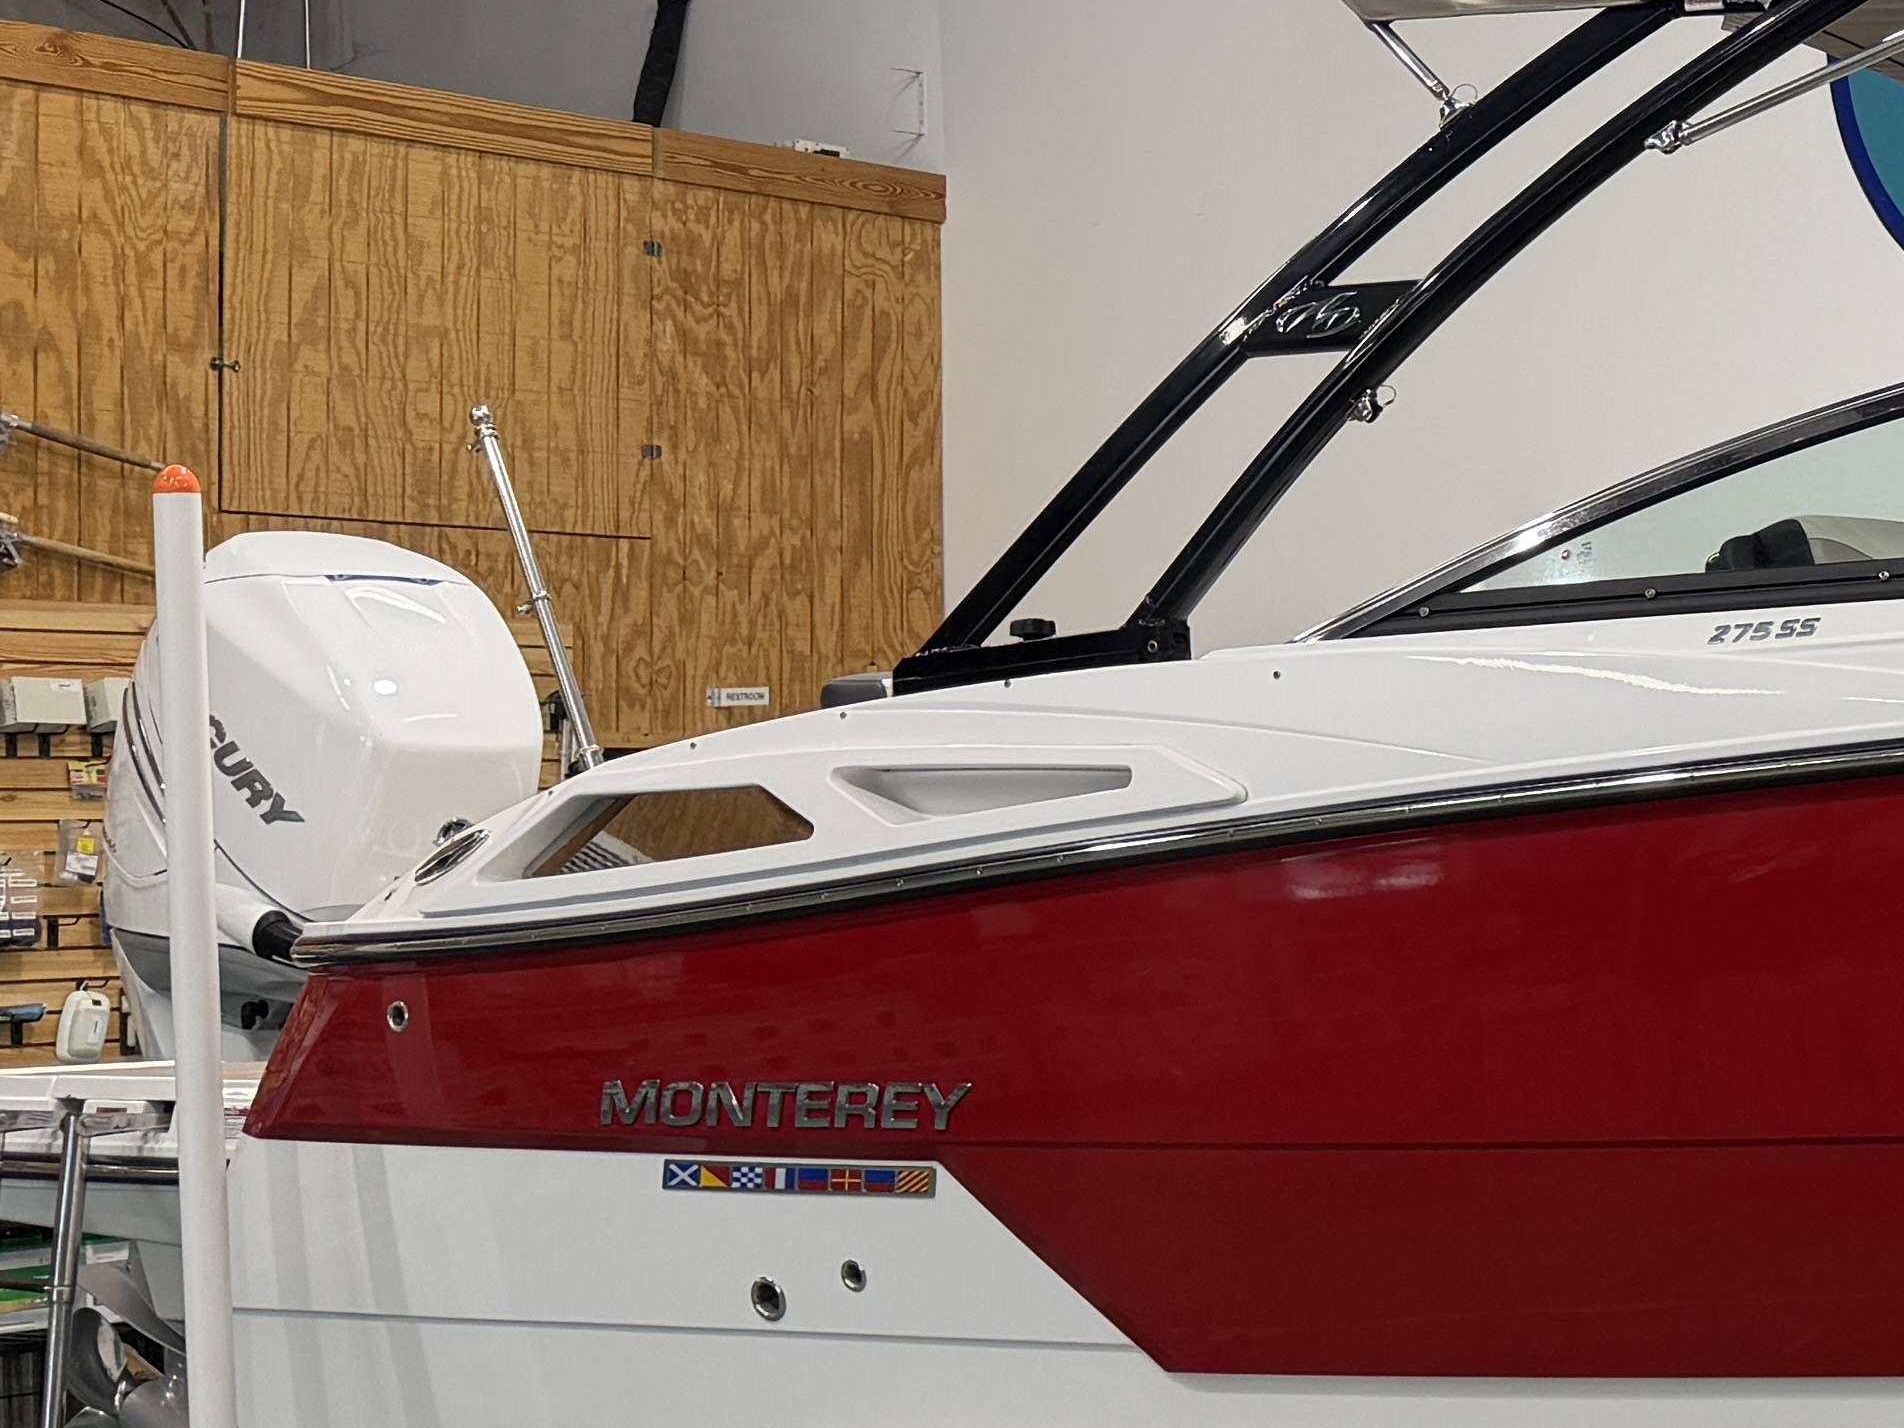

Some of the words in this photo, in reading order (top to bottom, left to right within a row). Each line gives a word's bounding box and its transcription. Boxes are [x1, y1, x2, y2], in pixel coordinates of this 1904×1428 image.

[1706, 620, 1775, 645] 275
[1774, 616, 1822, 640] SS
[600, 1078, 972, 1131] MONTEREY
